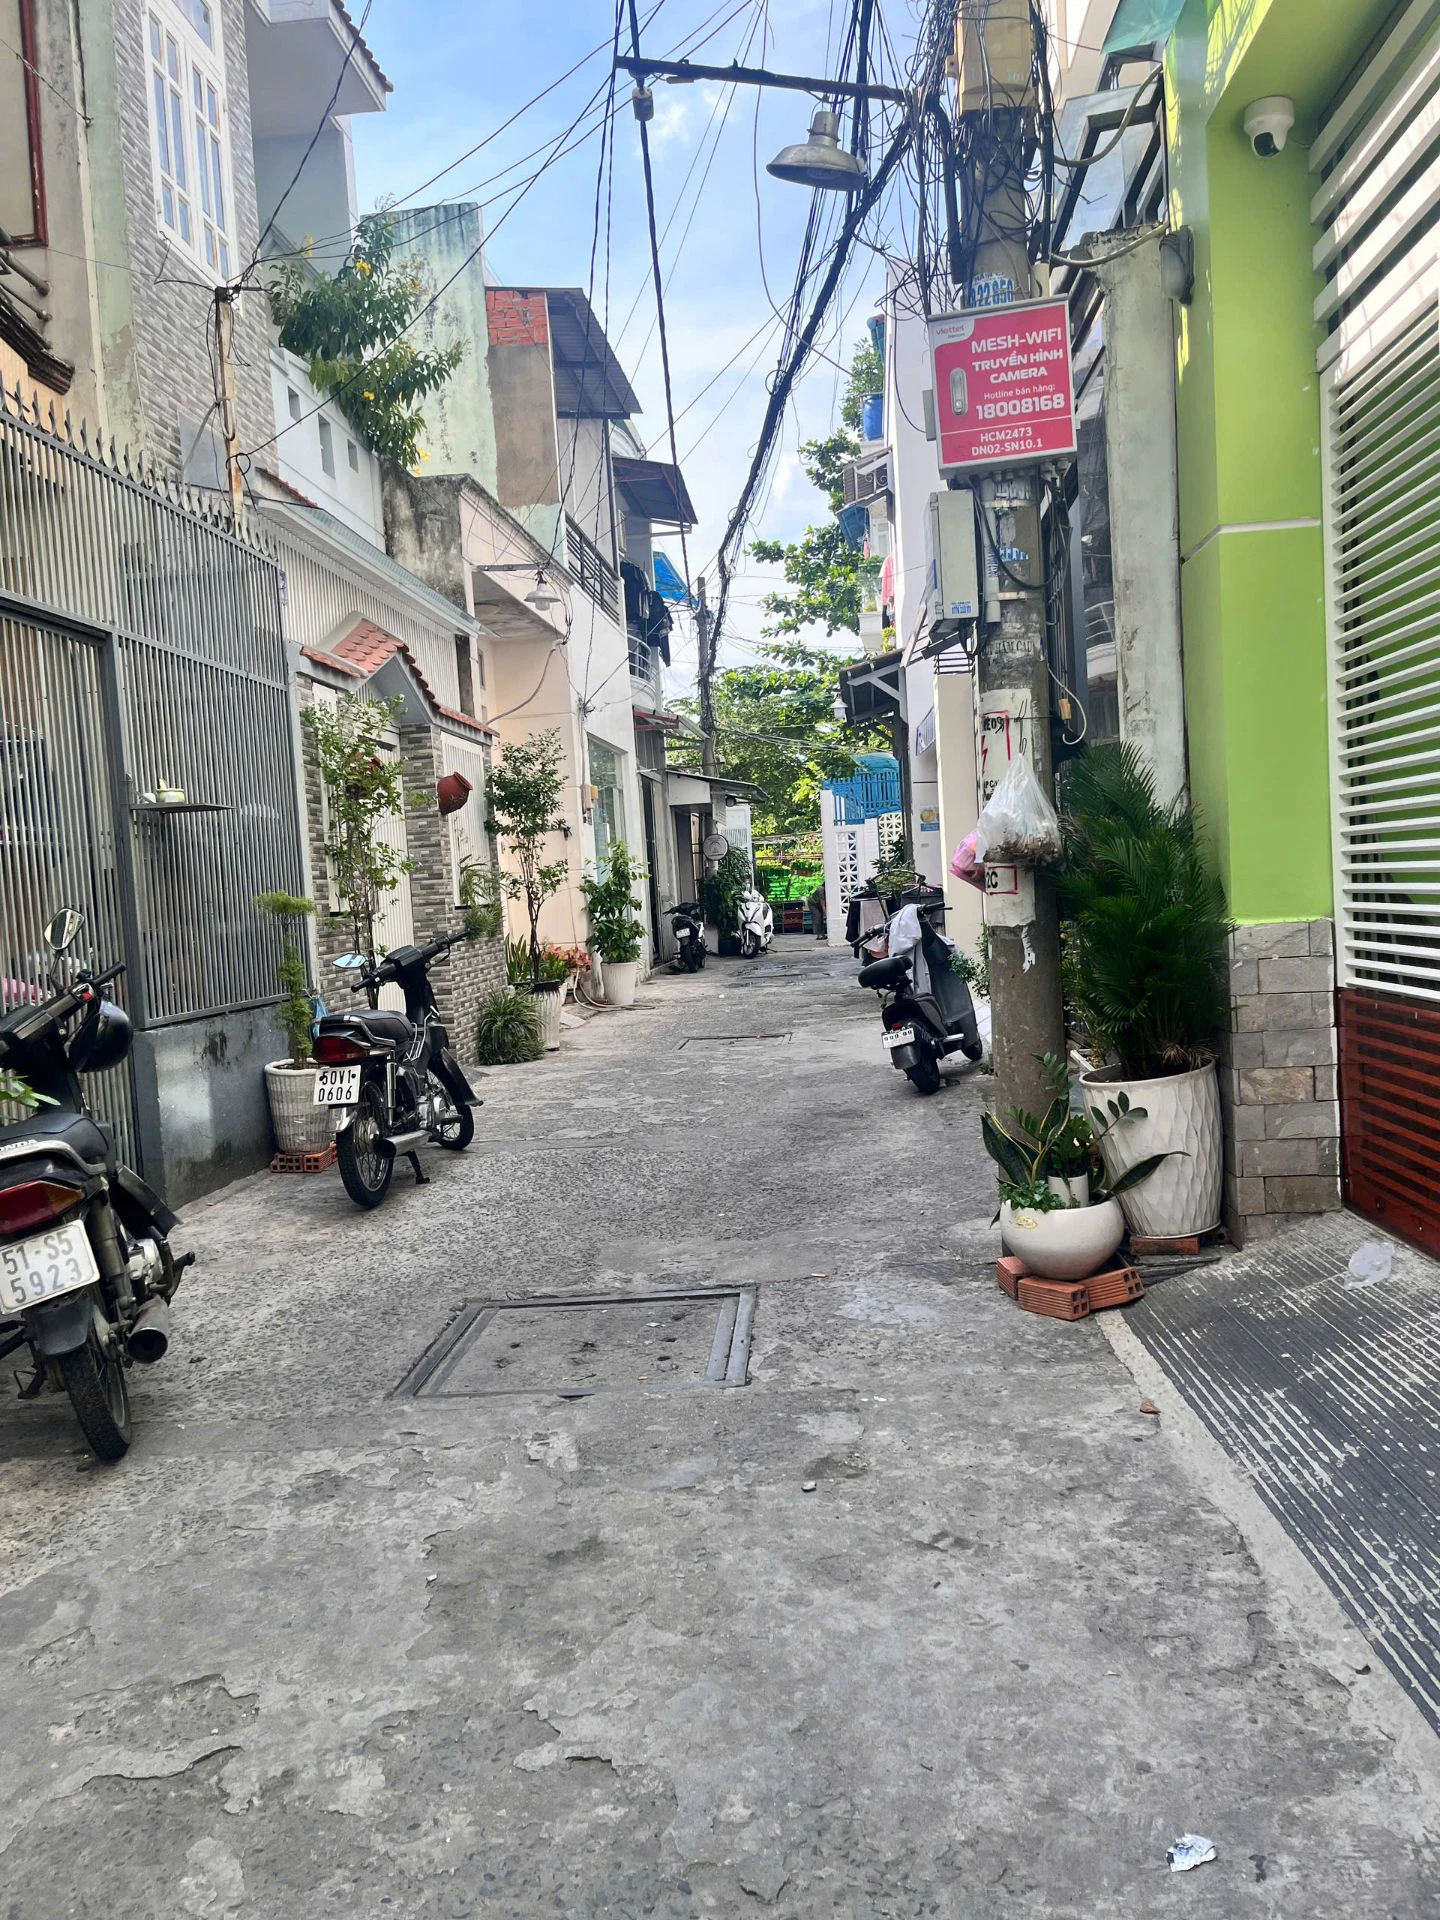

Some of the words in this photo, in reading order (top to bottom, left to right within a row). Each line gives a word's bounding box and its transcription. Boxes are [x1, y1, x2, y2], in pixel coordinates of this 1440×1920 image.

[971, 327, 1062, 354] MESH-WIFI
[971, 350, 1028, 372] TRUYỀN
[1029, 348, 1063, 363] HÌNH
[989, 366, 1049, 384] CAMERA
[983, 389, 1014, 400] Hotline
[1015, 387, 1031, 395] bán
[976, 393, 1065, 420] 18008168
[980, 426, 1032, 442] HCM2473
[971, 438, 1043, 456] DN02-SN10.1
[322, 1069, 352, 1085] 50V1
[318, 1085, 353, 1102] 0606
[10, 1257, 82, 1304] 5923
